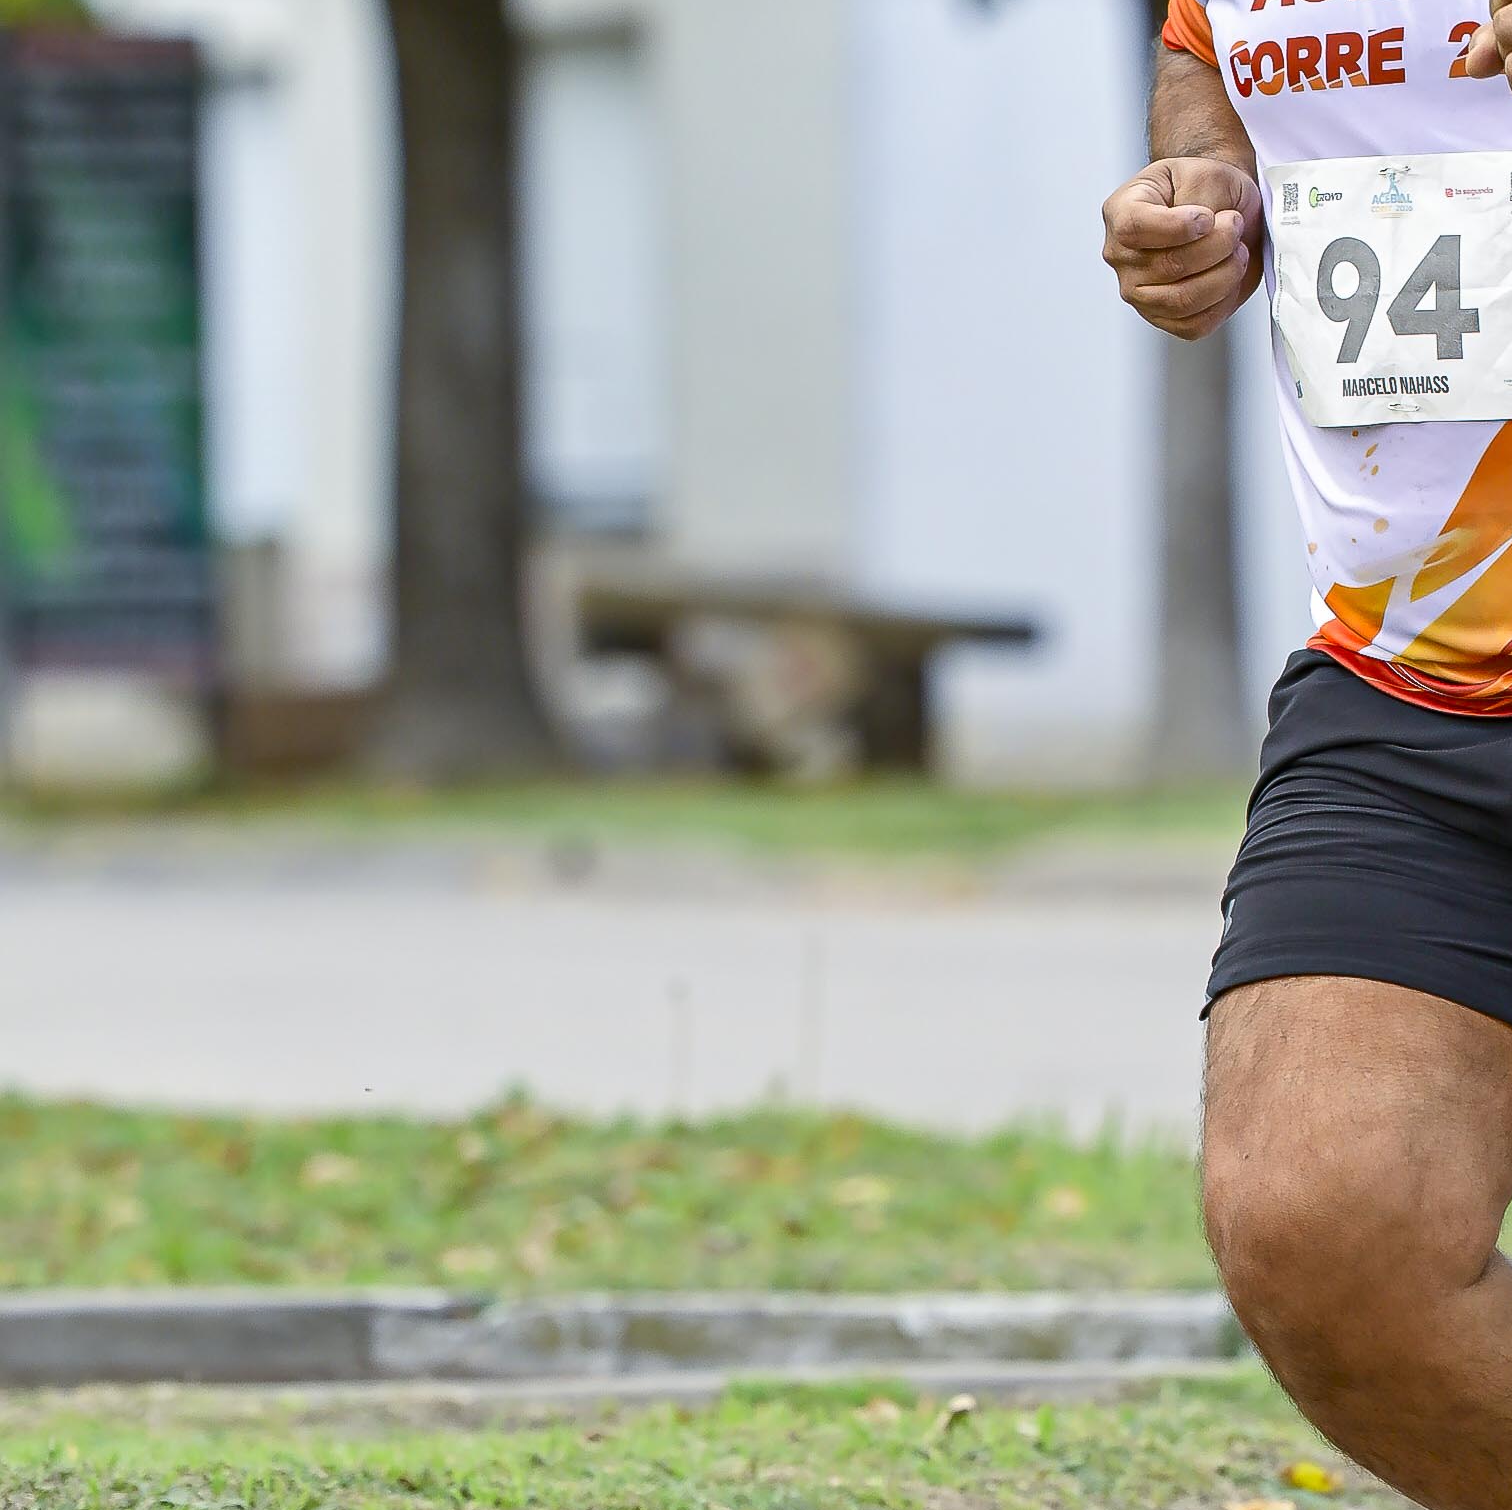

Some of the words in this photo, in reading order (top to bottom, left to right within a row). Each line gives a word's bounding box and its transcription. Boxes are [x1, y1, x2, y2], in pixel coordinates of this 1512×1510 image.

[1229, 26, 1406, 98] CORRE
[1317, 234, 1480, 364] 94
[1342, 376, 1398, 397] MARCELO
[1399, 375, 1450, 395] NAHASS
